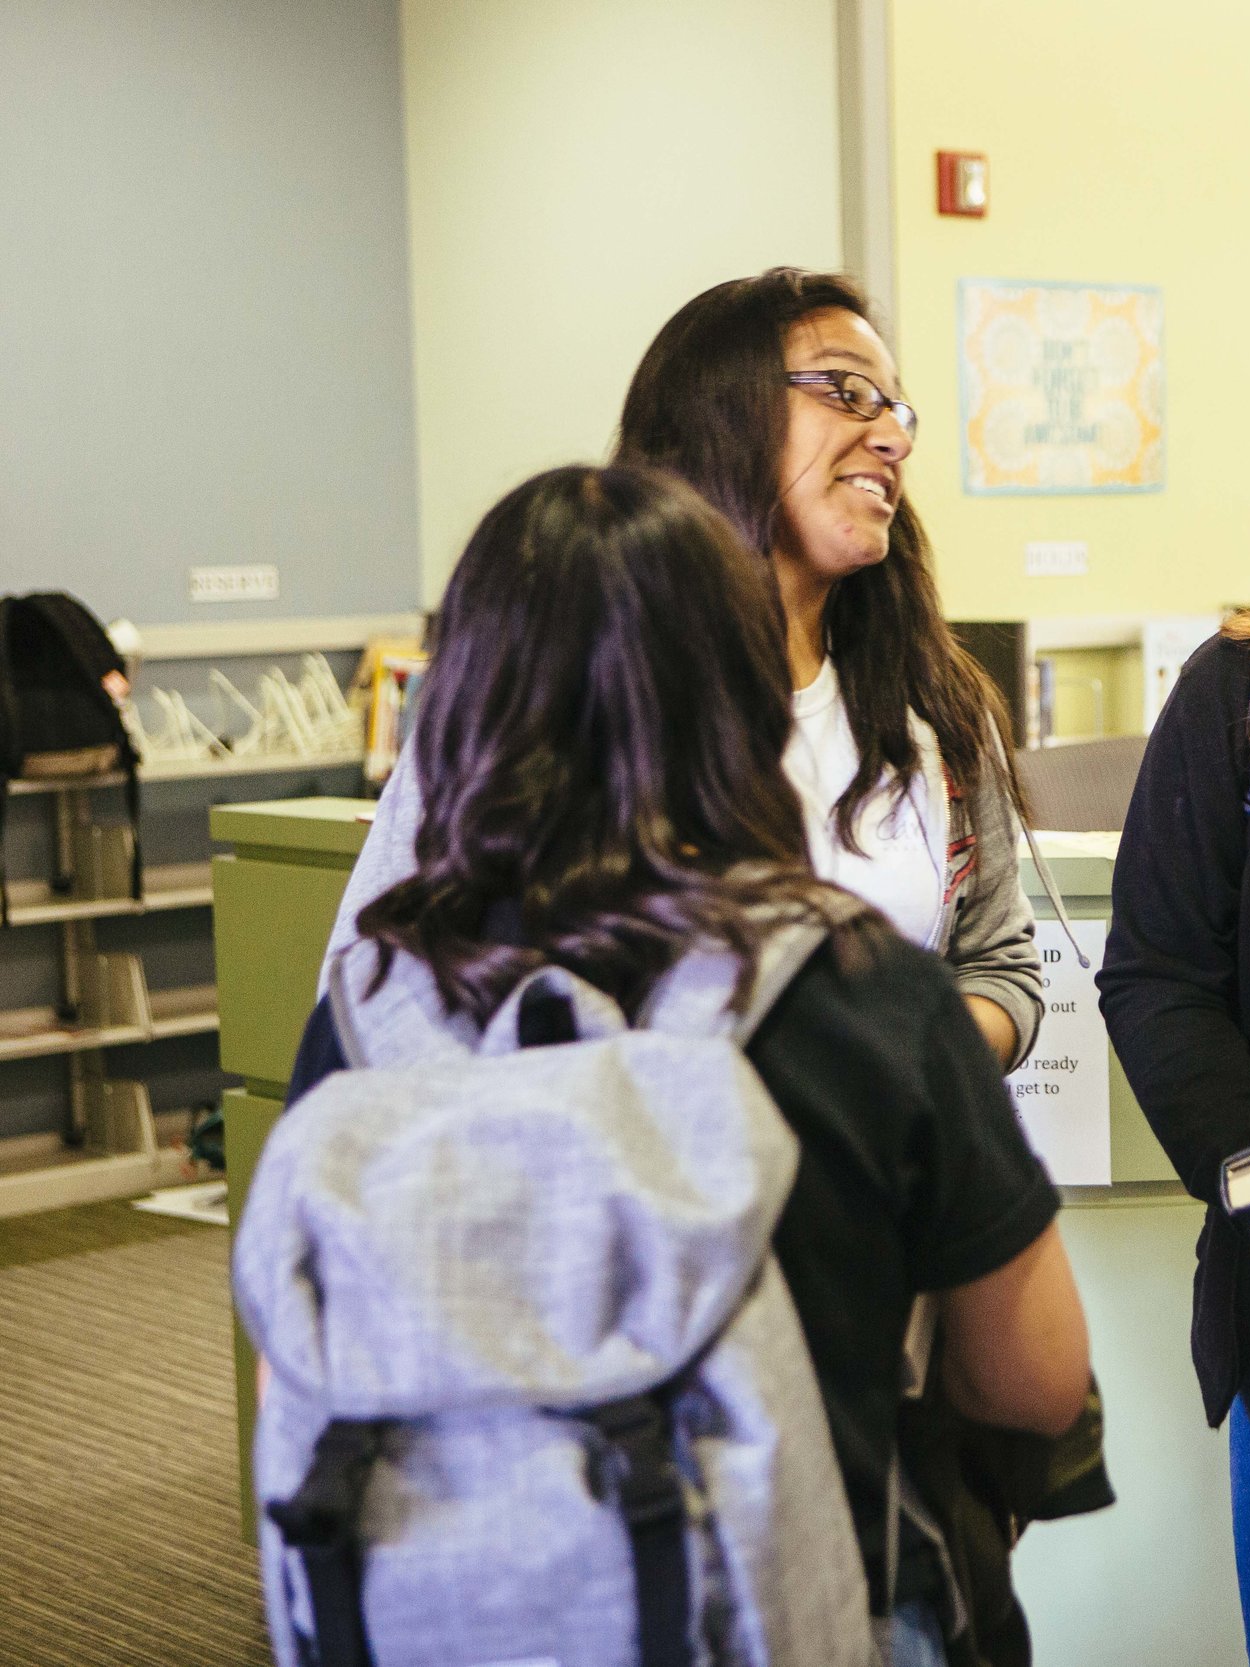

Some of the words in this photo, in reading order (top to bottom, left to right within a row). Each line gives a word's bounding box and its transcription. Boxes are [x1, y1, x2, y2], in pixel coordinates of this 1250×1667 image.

[1043, 949, 1061, 963] ID
[1043, 977, 1051, 988] o
[1051, 1001, 1077, 1013] out
[1034, 1056, 1079, 1074] ready
[1016, 1083, 1040, 1098] get
[1044, 1083, 1060, 1095] to
